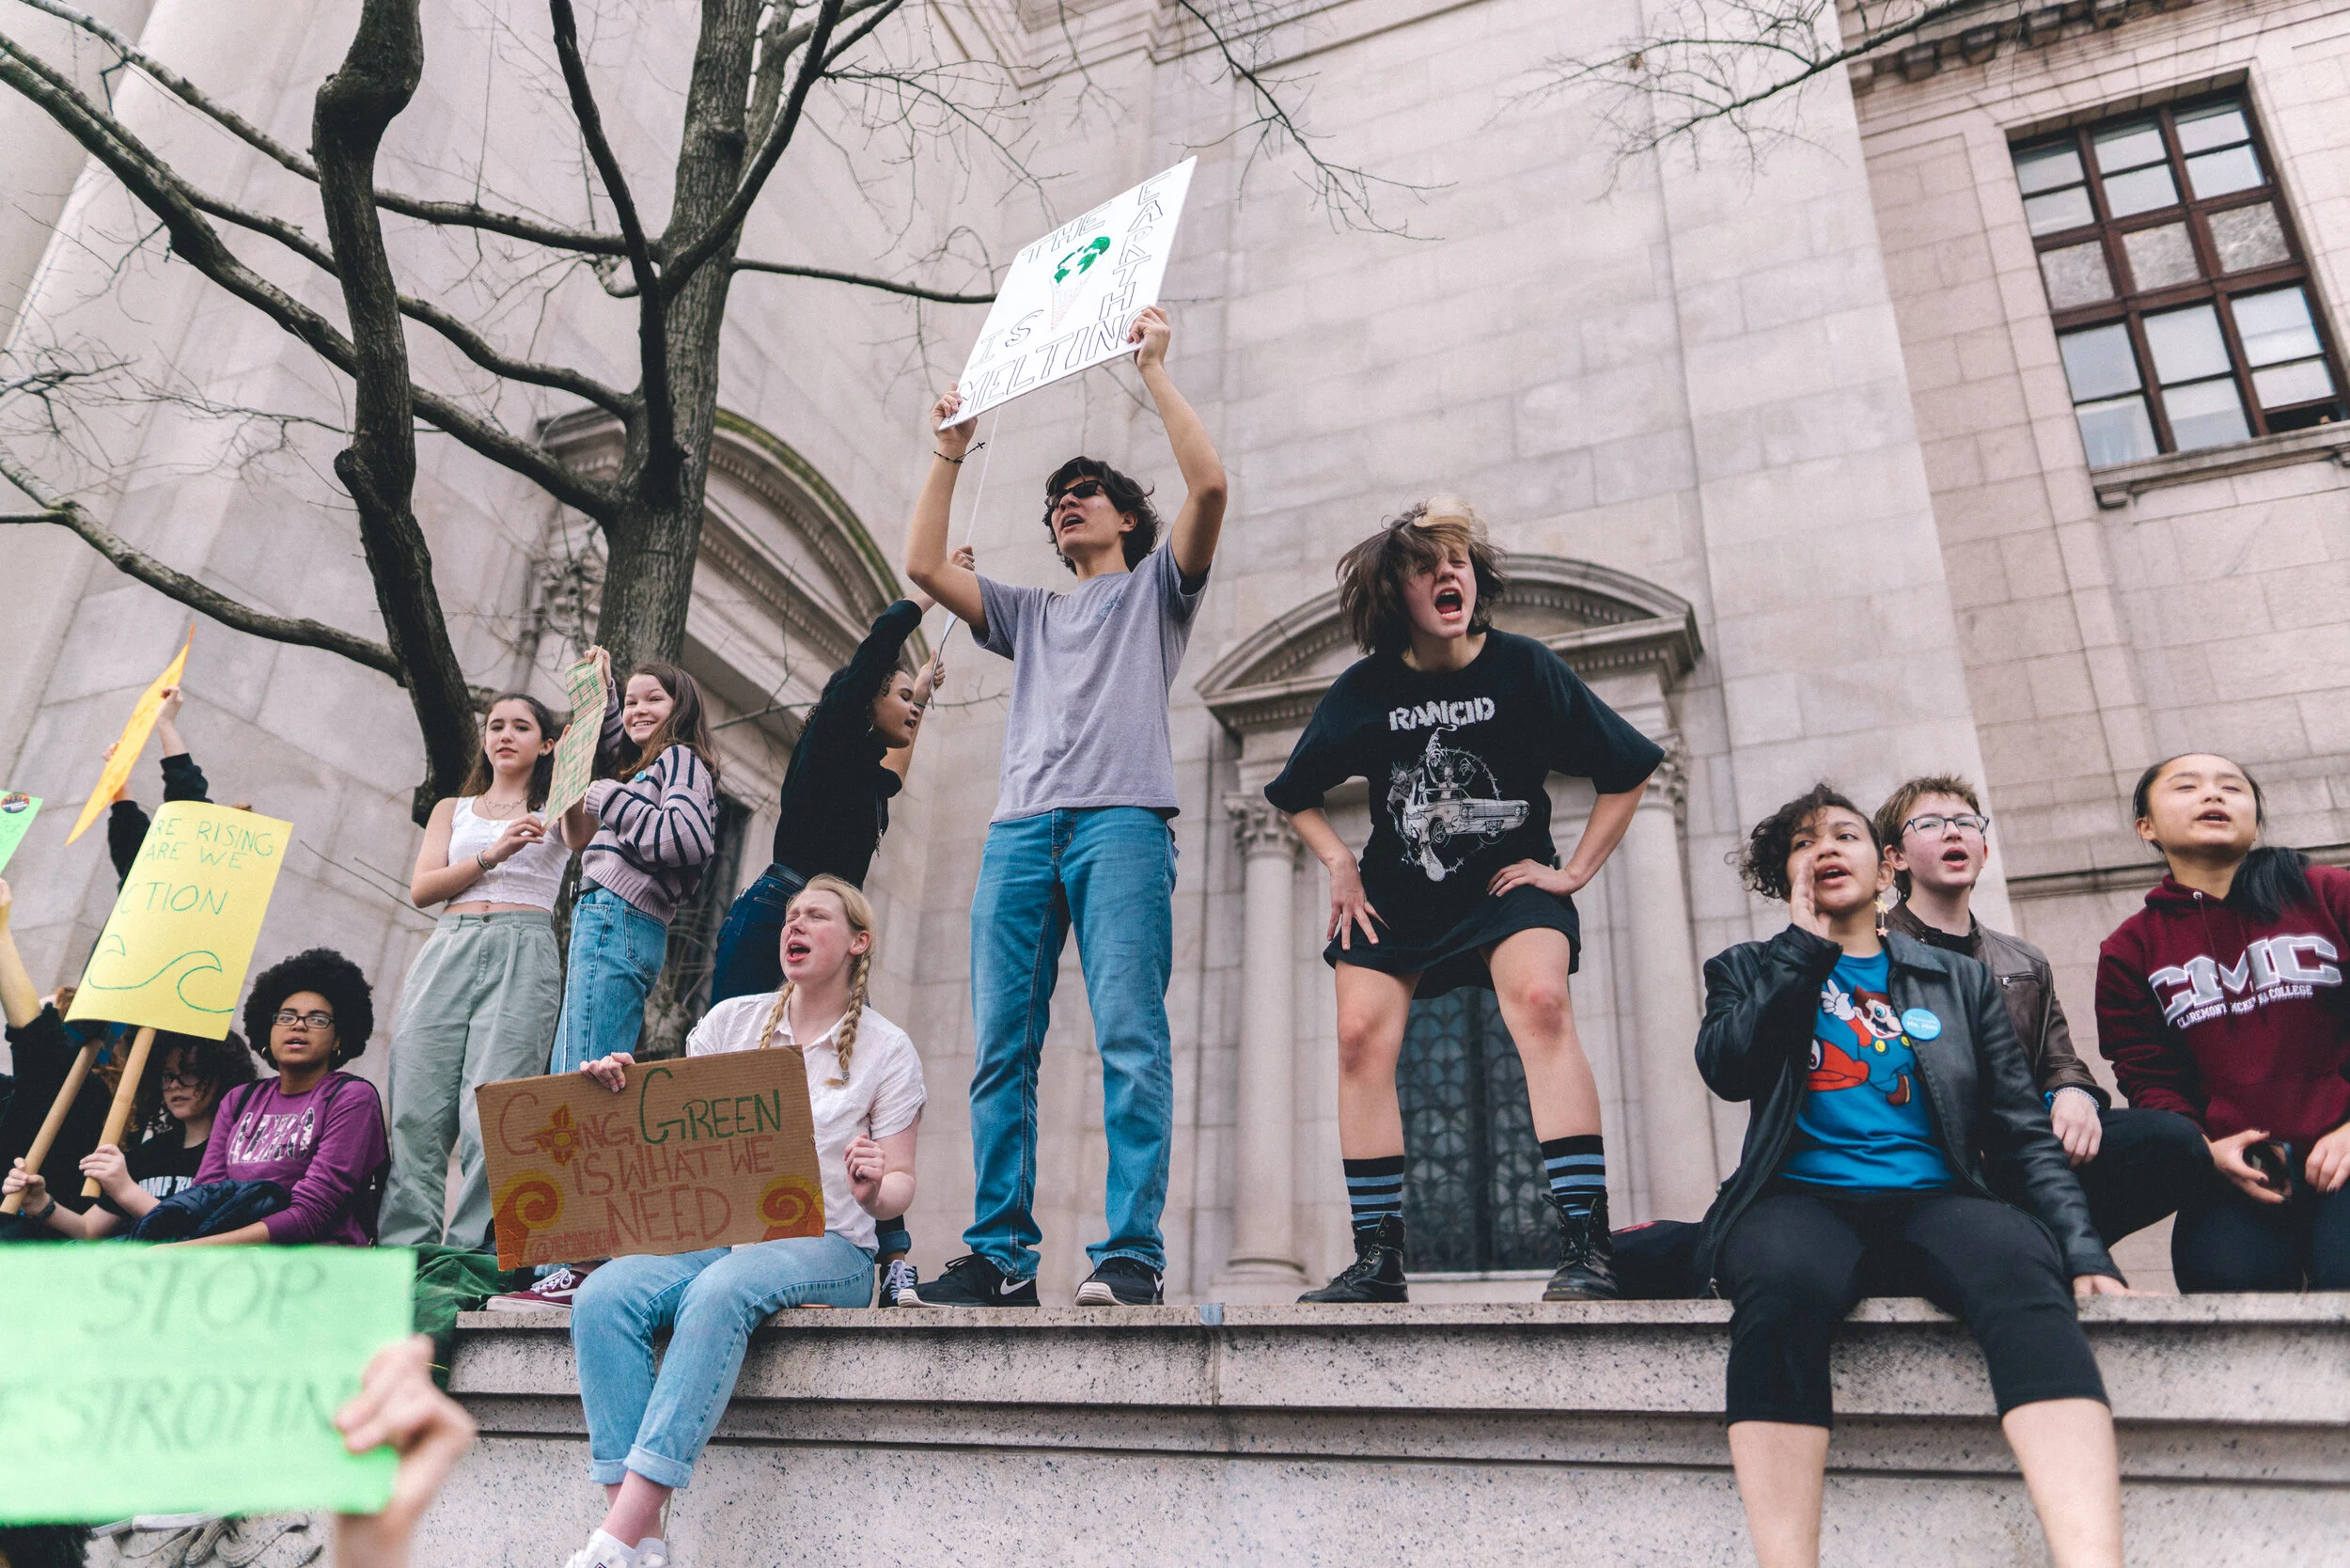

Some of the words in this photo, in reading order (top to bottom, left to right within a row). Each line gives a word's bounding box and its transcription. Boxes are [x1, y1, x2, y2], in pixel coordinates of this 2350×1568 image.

[1021, 201, 1113, 263] THE
[1099, 172, 1171, 321] EARTH
[970, 309, 1044, 369] IS
[1388, 697, 1496, 731] RANCID
[143, 841, 188, 861] ARE
[199, 845, 248, 869] WE
[196, 820, 274, 856] RISING
[119, 881, 228, 915] CTION
[2148, 934, 2342, 1027] CMC
[2268, 984, 2313, 1000] COLLEGE
[639, 1067, 781, 1145] GREEN
[572, 1152, 615, 1197] IS
[617, 1141, 723, 1193] WHAT
[727, 1134, 776, 1176] WE
[605, 1184, 732, 1248] NEED
[81, 1254, 329, 1336] STOP
